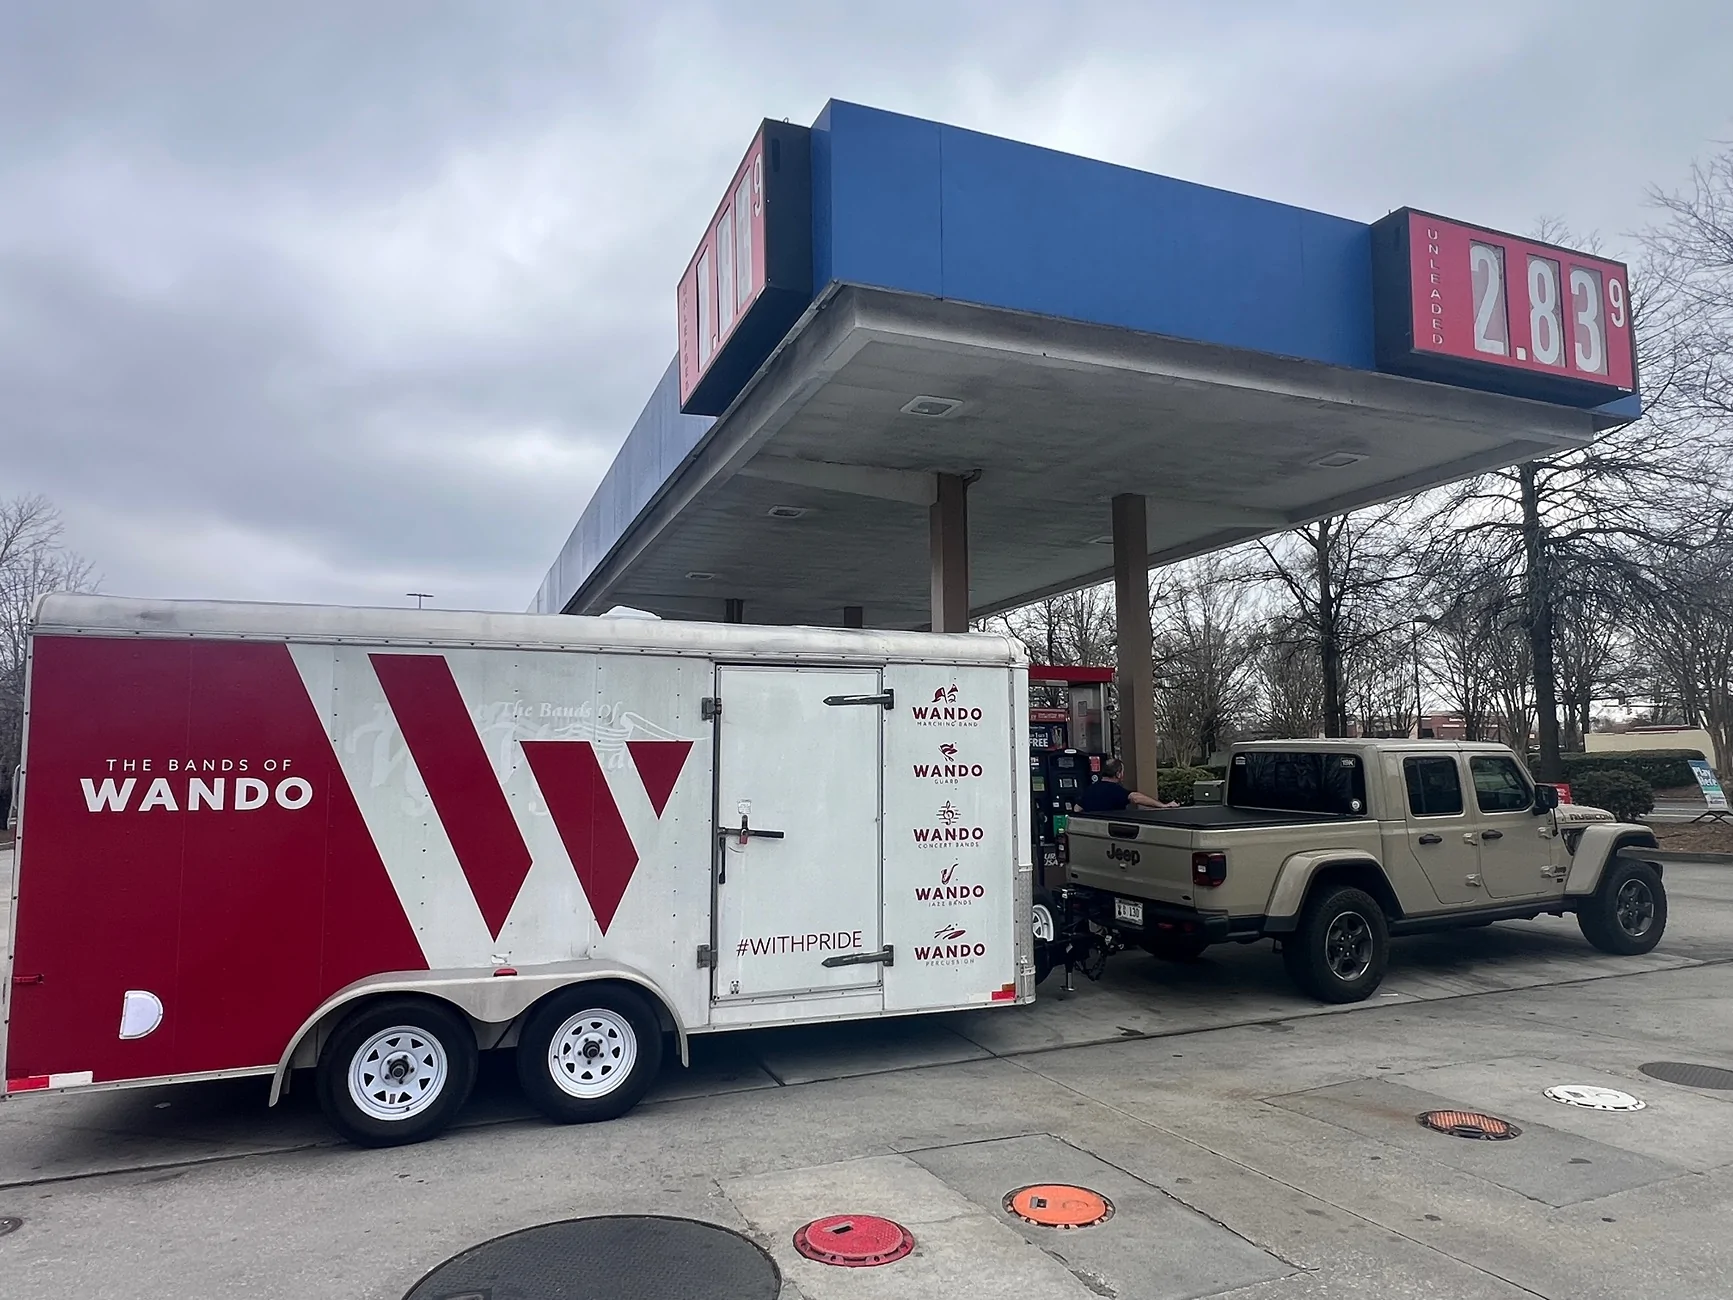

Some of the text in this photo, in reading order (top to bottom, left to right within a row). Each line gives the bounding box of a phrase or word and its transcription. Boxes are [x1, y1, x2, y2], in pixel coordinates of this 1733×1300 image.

[1427, 229, 1444, 344] UNLEADED
[1470, 245, 1626, 373] 2.83 9
[912, 706, 982, 720] WANDO
[106, 759, 292, 771] THE BANDS OF
[913, 764, 983, 777] WANDO
[80, 777, 313, 812] WANDO
[914, 828, 984, 842] WANDO
[1106, 843, 1141, 866] Jeep
[915, 885, 985, 900] WANDO
[736, 930, 862, 957] #WITHPRIDE
[915, 943, 985, 960] WANDO
[926, 959, 975, 967] PERCUSSION
